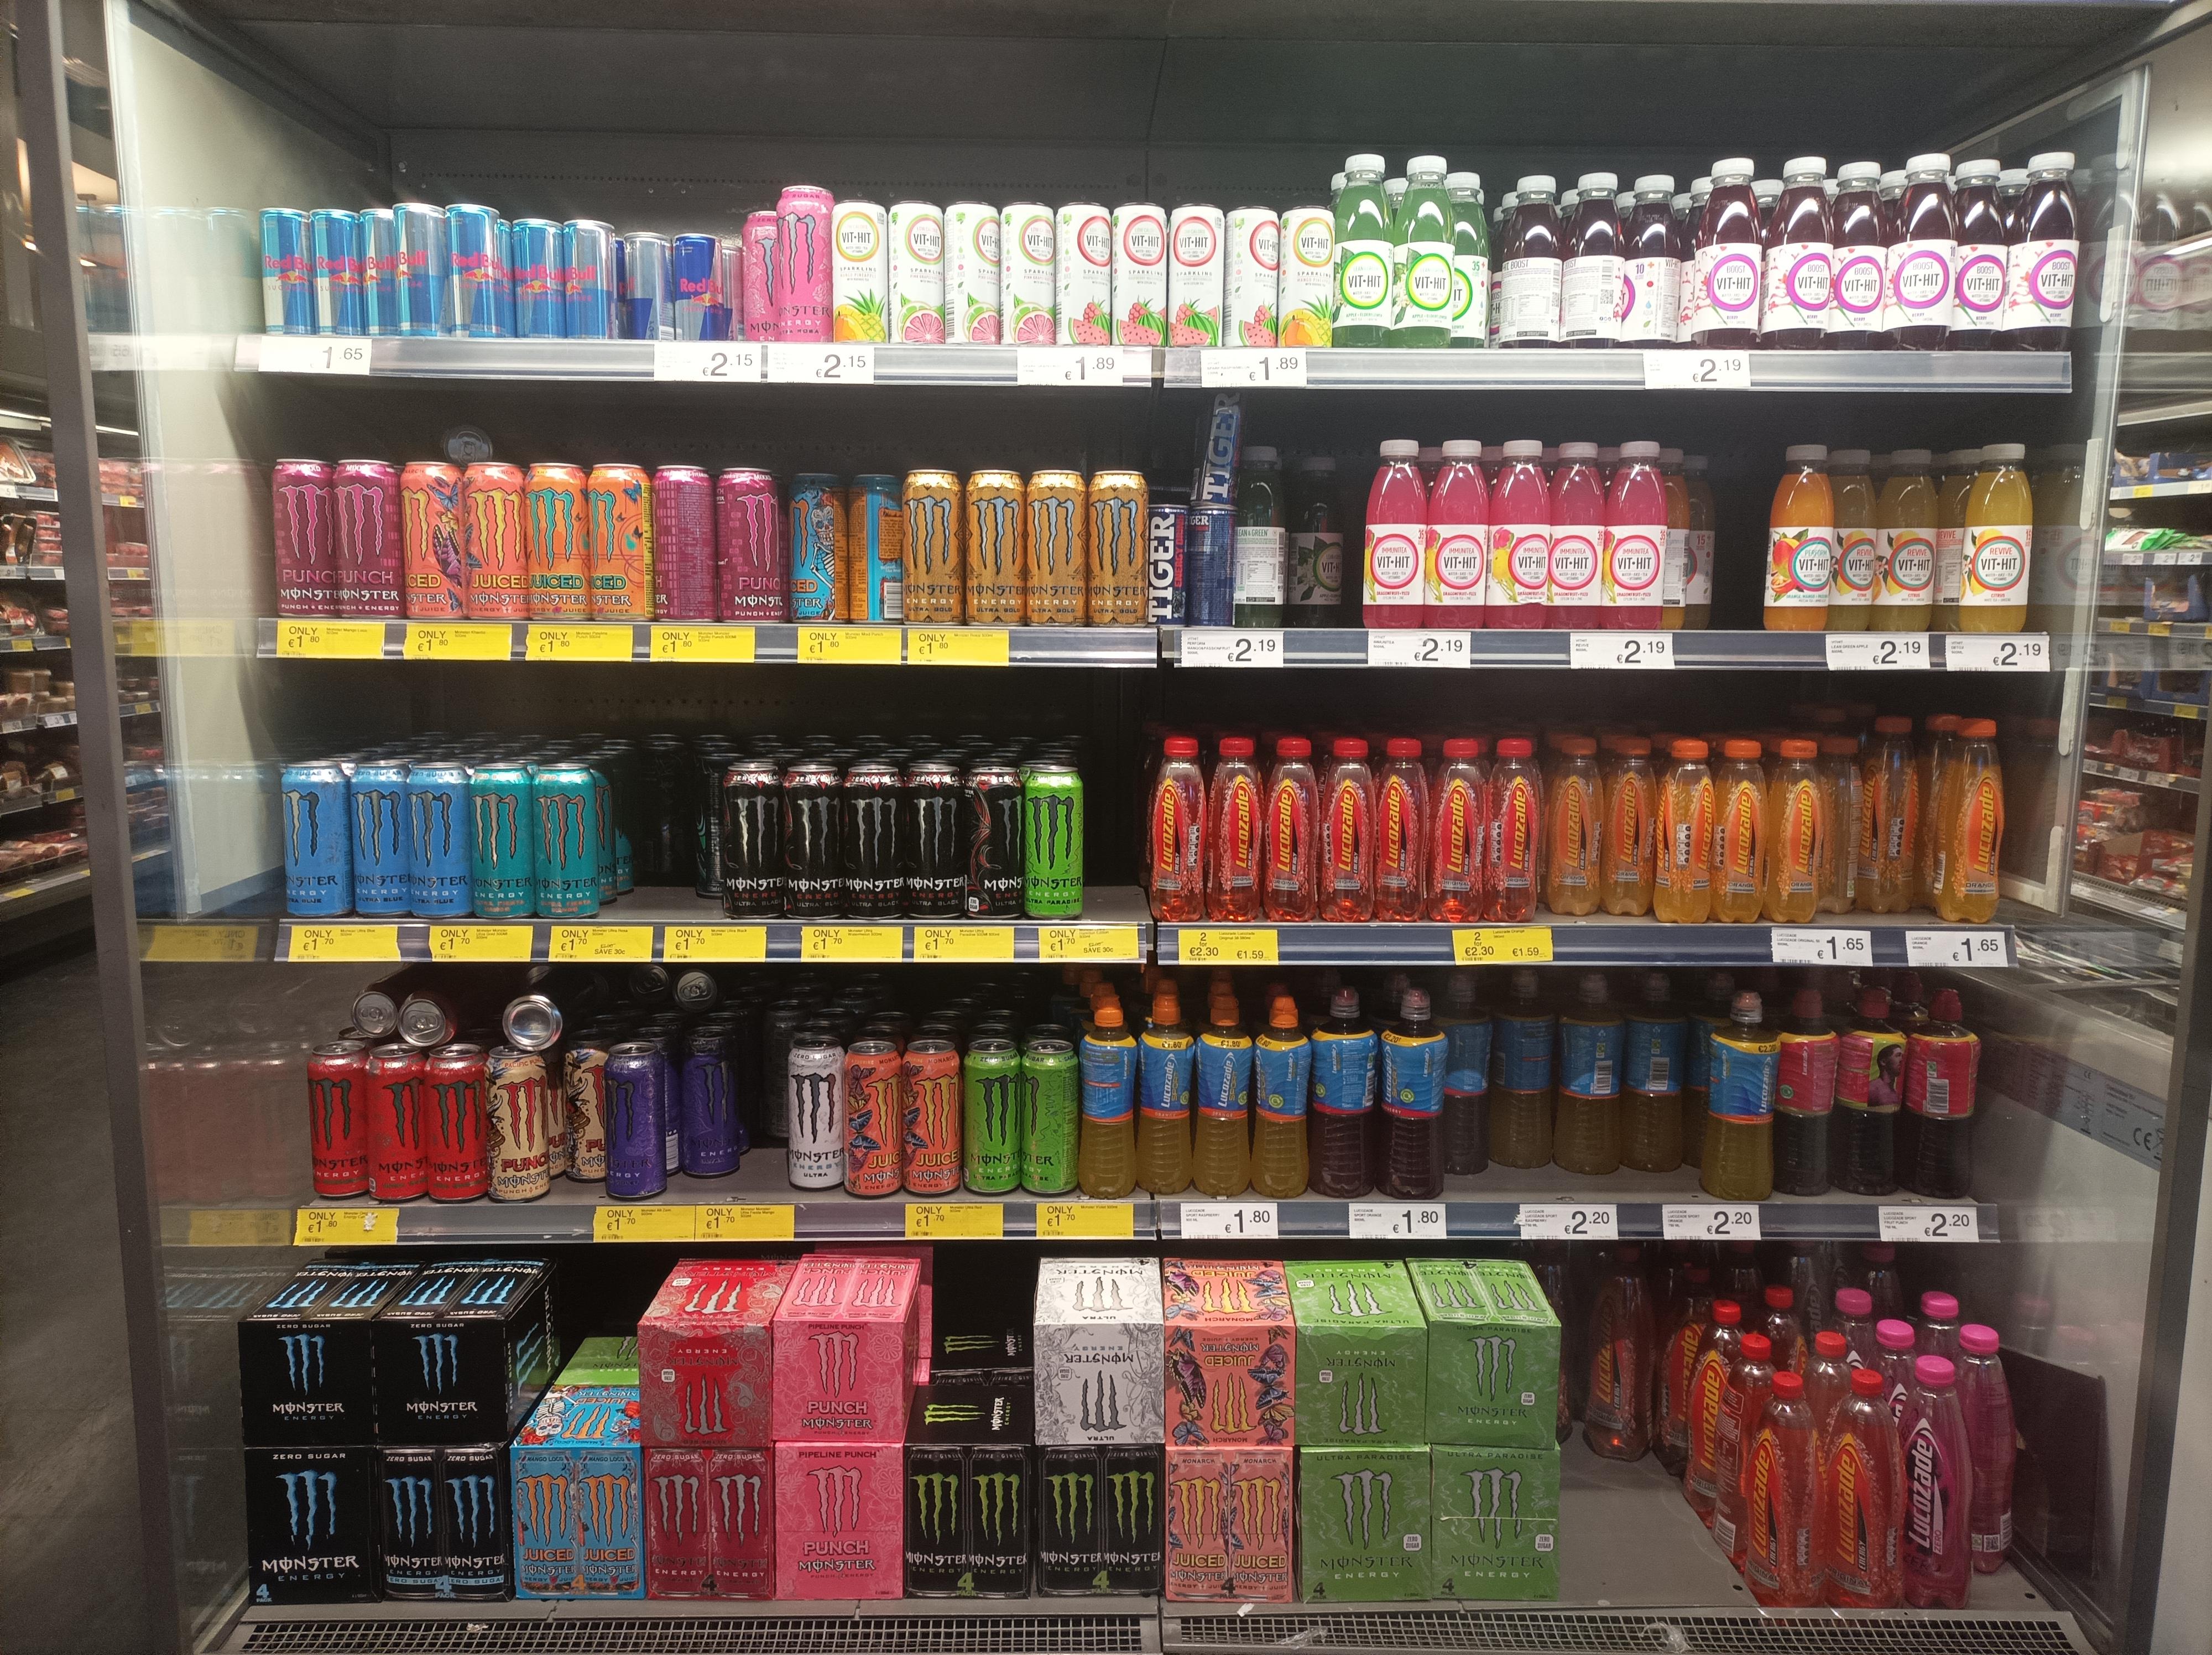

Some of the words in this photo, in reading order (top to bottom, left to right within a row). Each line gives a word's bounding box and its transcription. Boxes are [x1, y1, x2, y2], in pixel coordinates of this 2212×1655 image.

[1472, 261, 1480, 270] 35
[1636, 264, 1644, 274] 10
[1977, 266, 1994, 274] BOOST
[2052, 262, 2070, 270] BOOST
[1204, 392, 1240, 501] TIGER
[1937, 530, 1956, 539] REVIVE
[1149, 514, 1176, 623] TIGER
[289, 626, 317, 635] ONLY
[418, 630, 446, 639] ONLY
[540, 632, 567, 640] ONLY
[662, 632, 690, 640] ONLY
[809, 632, 837, 641] ONLY
[919, 634, 946, 642] ONLY
[1161, 793, 1175, 872] Lucozade
[1338, 793, 1354, 872] Lucozade
[1447, 792, 1464, 872] Lucozade
[1795, 793, 1812, 873] Lucozade
[1974, 789, 1994, 872] Lucozade
[304, 930, 332, 938] ONLY
[441, 929, 468, 938] ONLY
[562, 930, 588, 939] ONLY
[676, 930, 702, 939] ONLY
[813, 930, 840, 939] ONLY
[925, 930, 951, 938] ONLY
[1049, 930, 1076, 939] ONLY
[1201, 933, 1206, 941] 2
[1474, 932, 1480, 940] 2
[1190, 947, 1219, 956] €2.30
[1237, 950, 1264, 959] €1.59
[1465, 946, 1494, 956] €2.30
[1512, 947, 1539, 956] €1.59
[1219, 1060, 1232, 1107] Lucozade
[607, 1209, 634, 1218] ONLY
[706, 1208, 733, 1216] ONLY
[916, 1206, 942, 1215] ONLY
[1047, 1206, 1073, 1215] ONLY
[309, 1211, 336, 1221] ONLY
[808, 1402, 867, 1414] PUNCH
[1909, 1439, 1934, 1549] Lucozade
[1752, 1449, 1770, 1558] Lucozade
[1837, 1454, 1856, 1565] Lucozade
